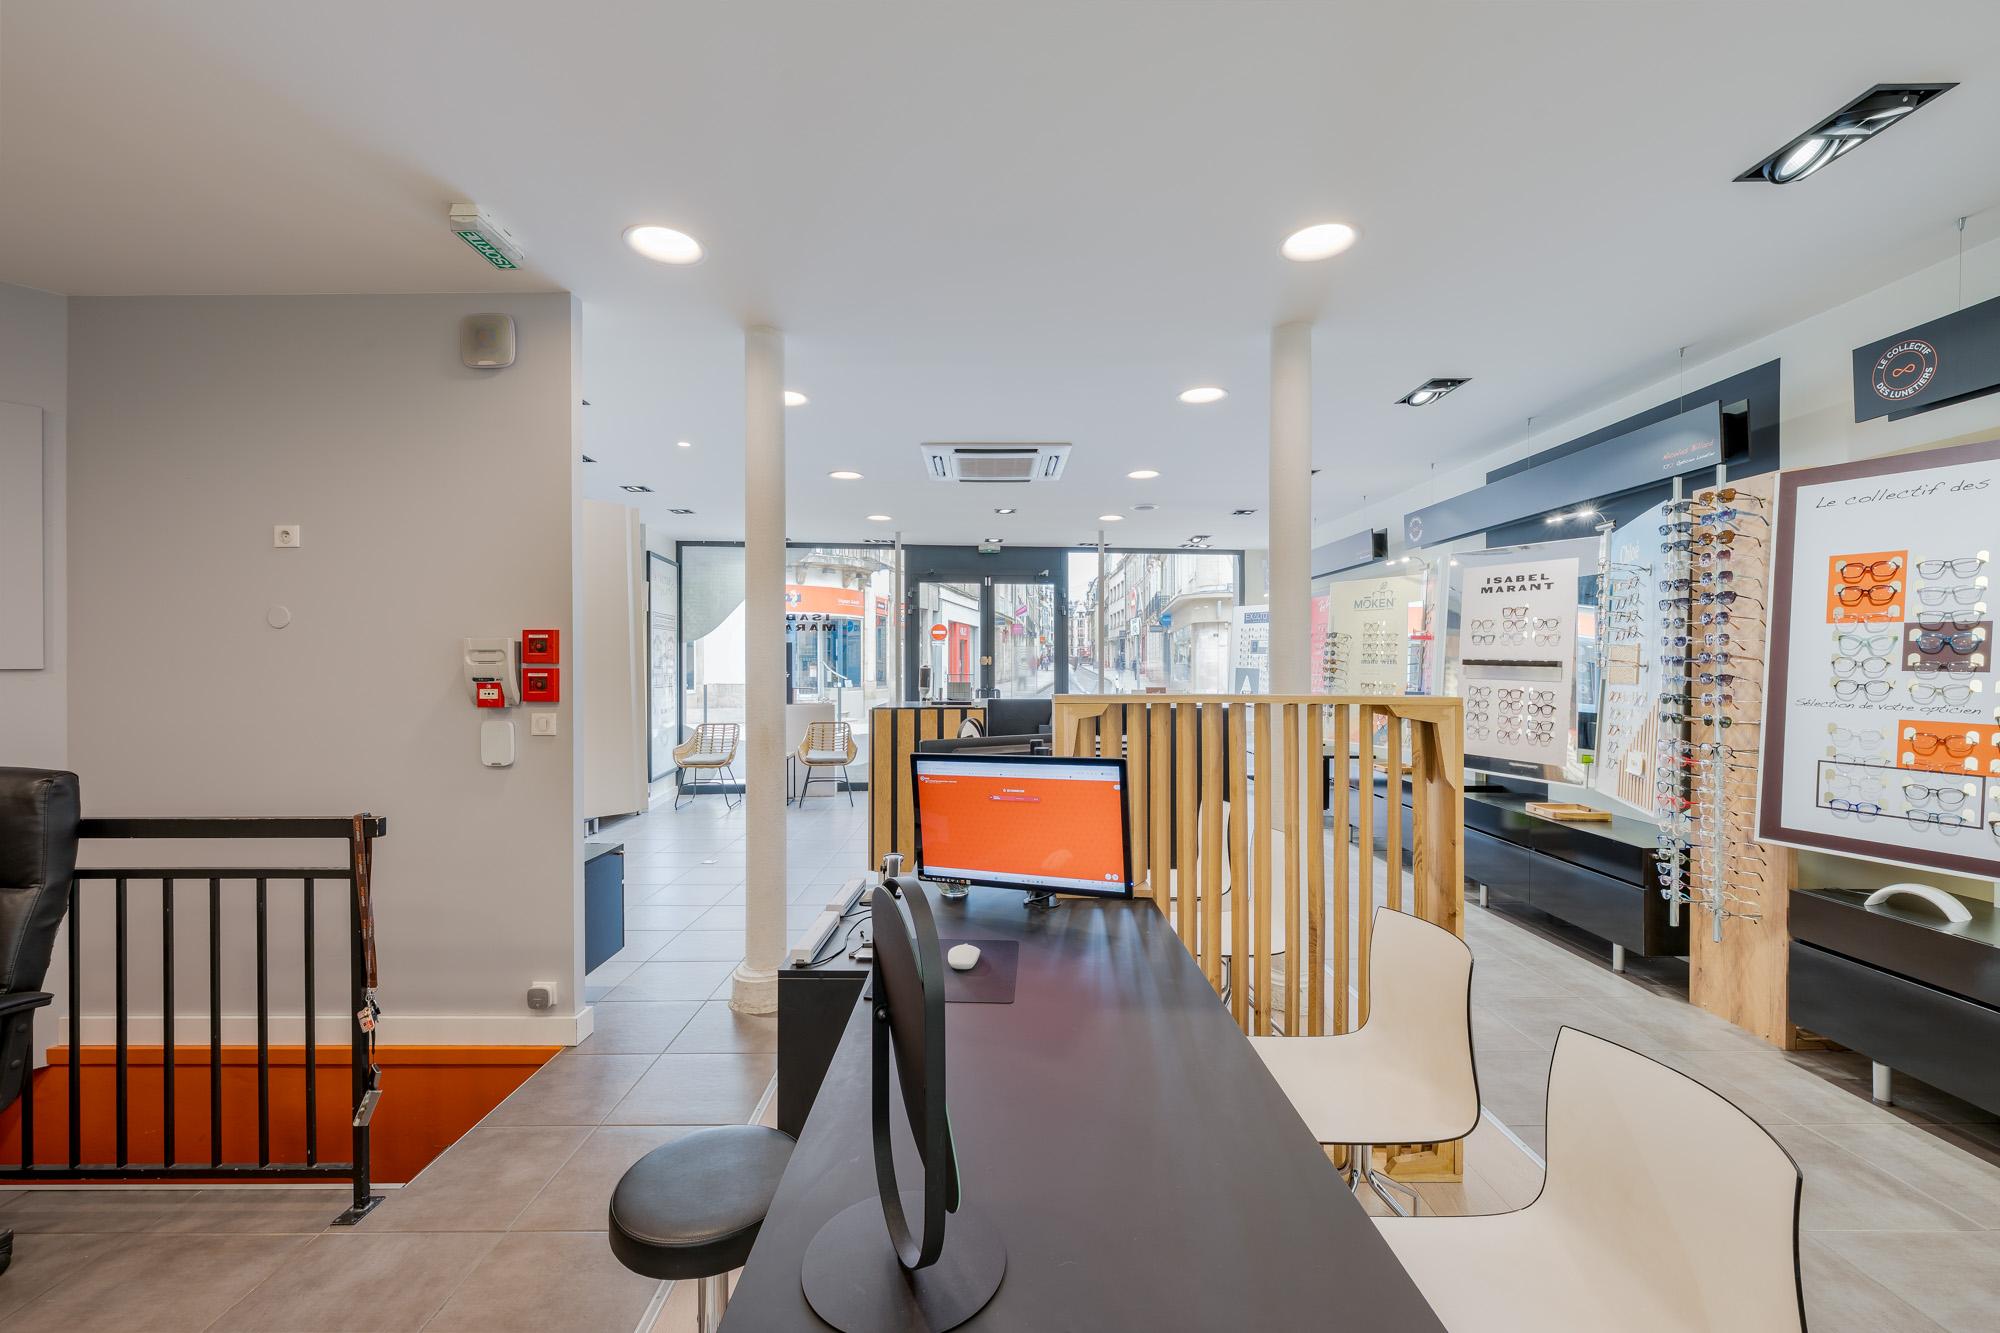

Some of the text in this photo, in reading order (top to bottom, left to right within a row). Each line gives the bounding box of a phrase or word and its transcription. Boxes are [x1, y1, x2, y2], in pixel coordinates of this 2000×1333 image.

[461, 231, 510, 265] SORTIE
[1877, 342, 1931, 369] LE COLLECTIF
[1876, 367, 1933, 398] DES LUNETIERS
[1816, 478, 1991, 509] Le collectif des
[1480, 582, 1555, 594] MARANT
[1486, 573, 1550, 585] ISABEL
[1795, 697, 1982, 715] Sélection de votre opticien
